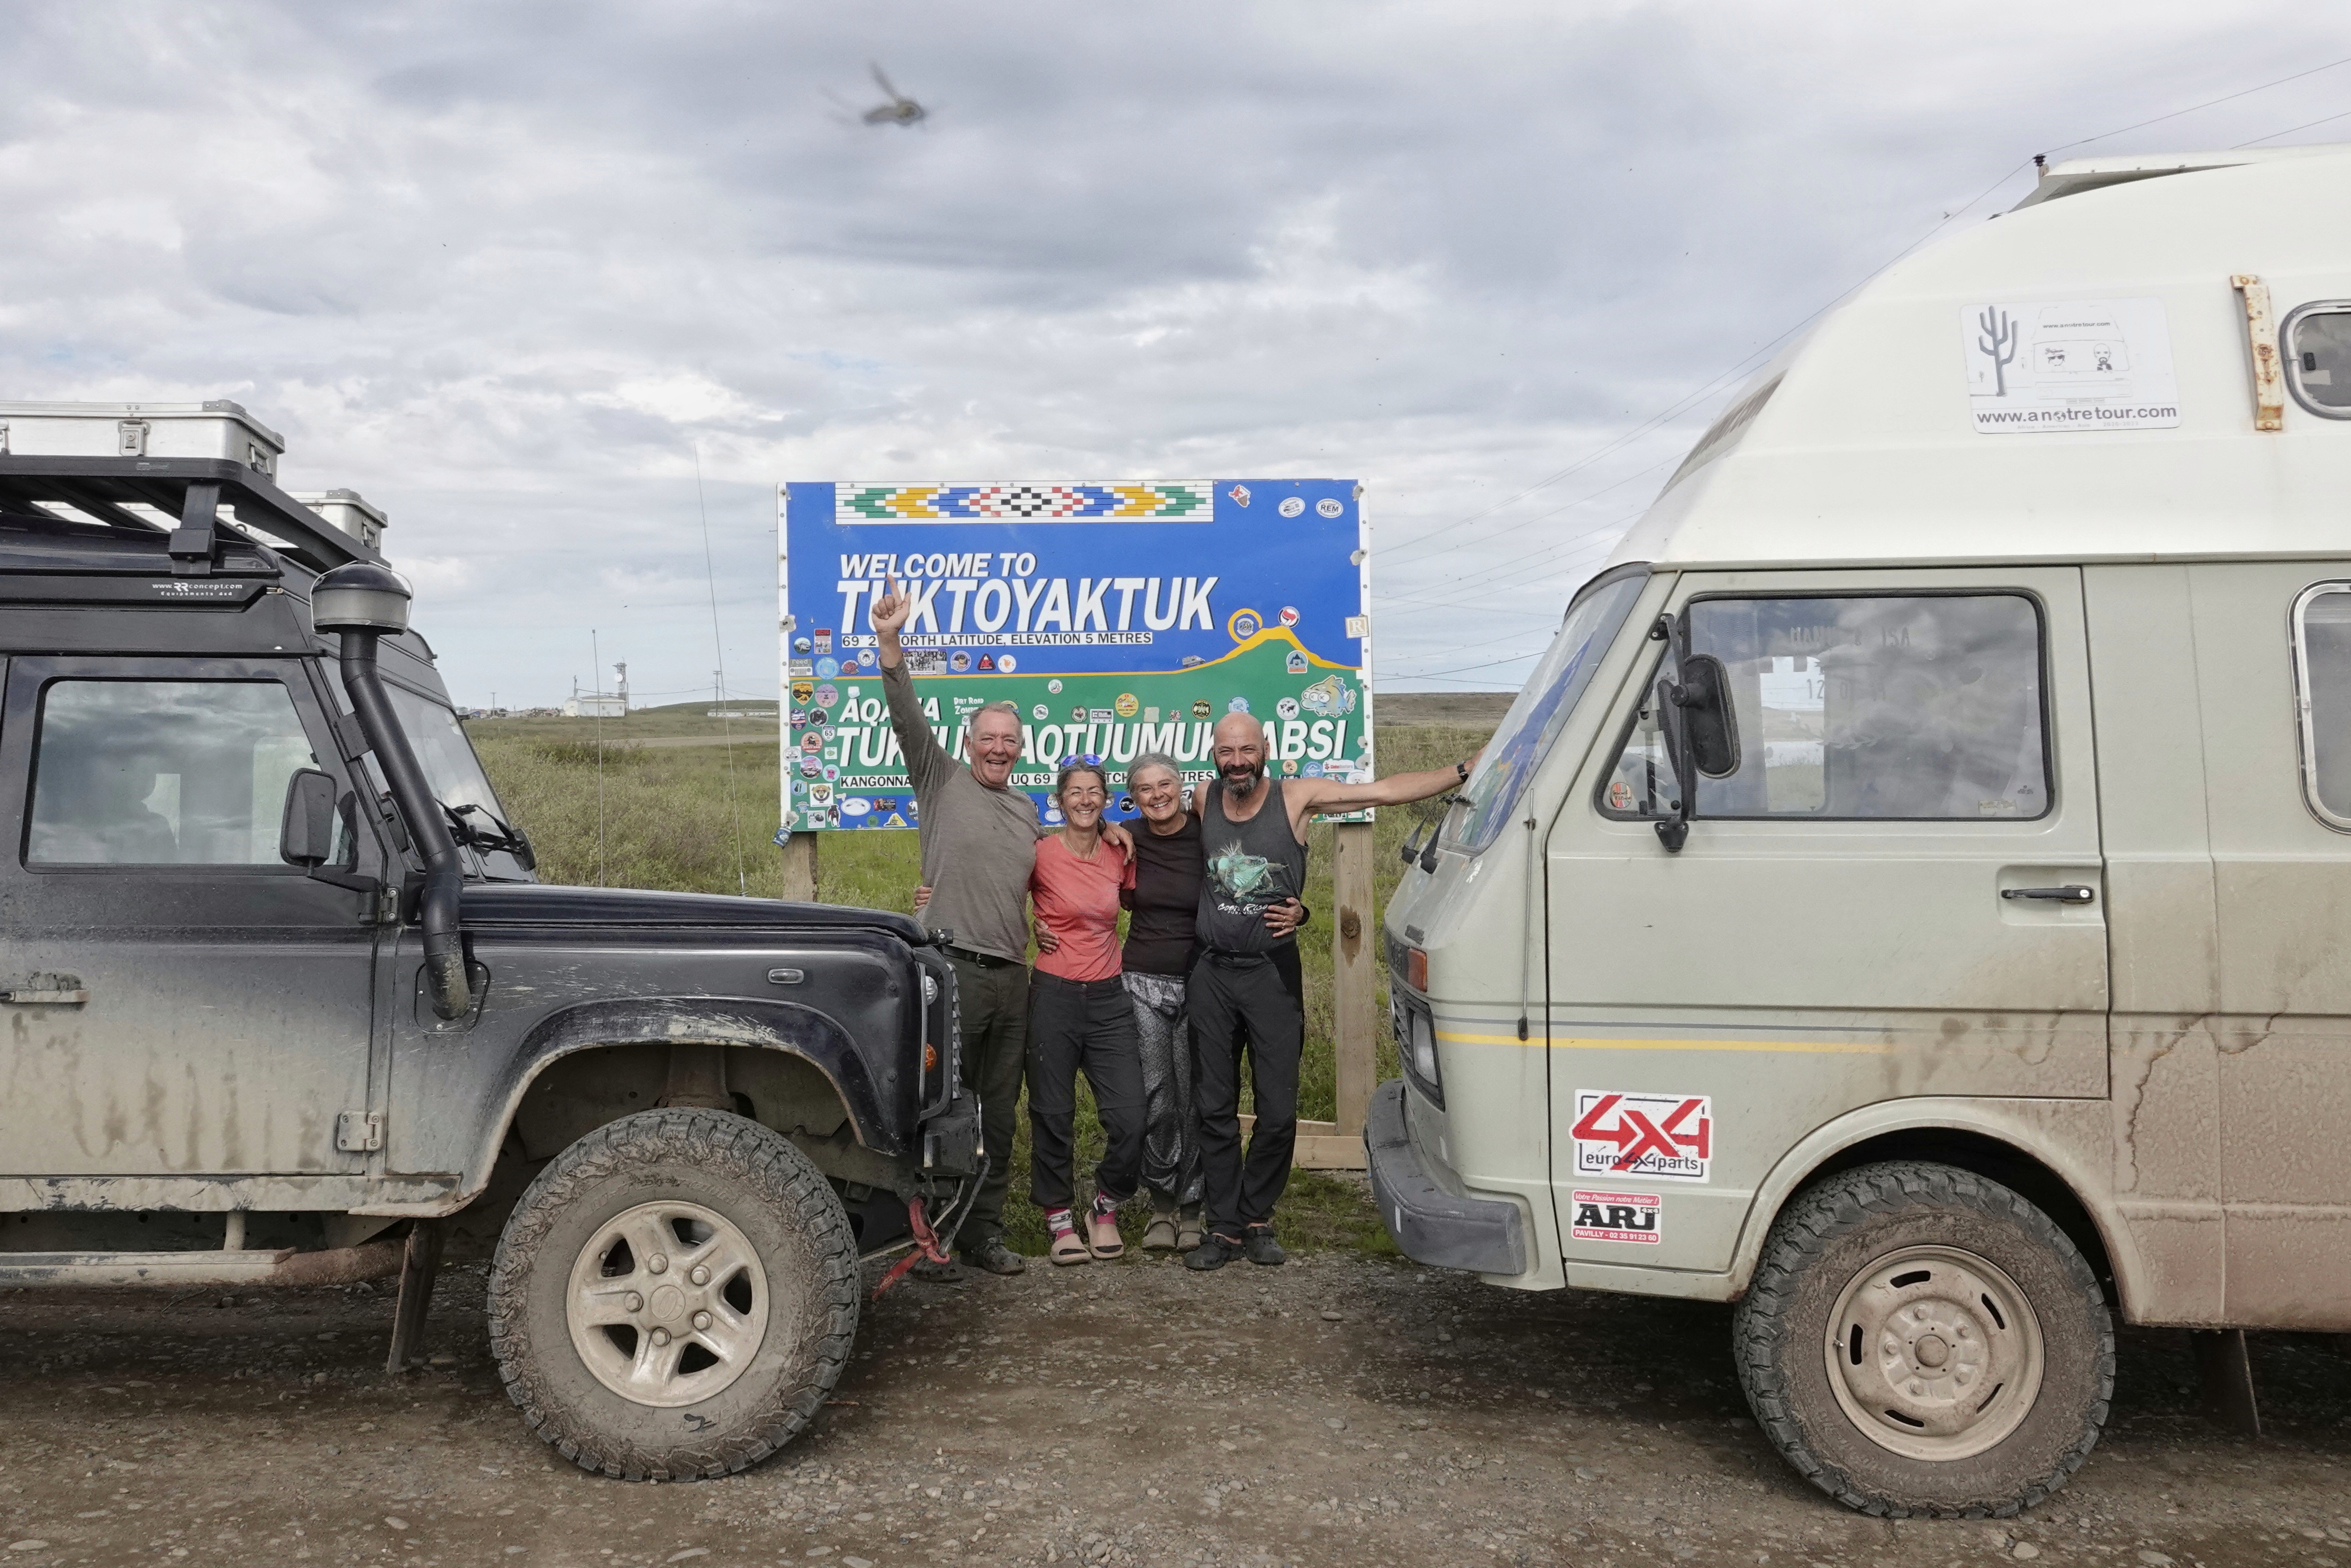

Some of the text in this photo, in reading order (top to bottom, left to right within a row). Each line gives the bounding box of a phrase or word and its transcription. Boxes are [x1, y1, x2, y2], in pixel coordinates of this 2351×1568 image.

[1320, 504, 1339, 513] REM
[840, 552, 1038, 578] WELCOME TO
[152, 582, 243, 592] www.RRconcept.com
[1350, 620, 1364, 632] R
[898, 635, 936, 646] ORTH
[941, 635, 1006, 647] LATITUDE,
[1011, 633, 1081, 645] ELEVATION
[1085, 633, 1093, 643] 5
[1097, 632, 1151, 643] METRES
[1586, 1152, 1699, 1171] euro4x4parts
[1574, 1203, 1656, 1230] ARJ
[1575, 1229, 1604, 1238] PAVILLY
